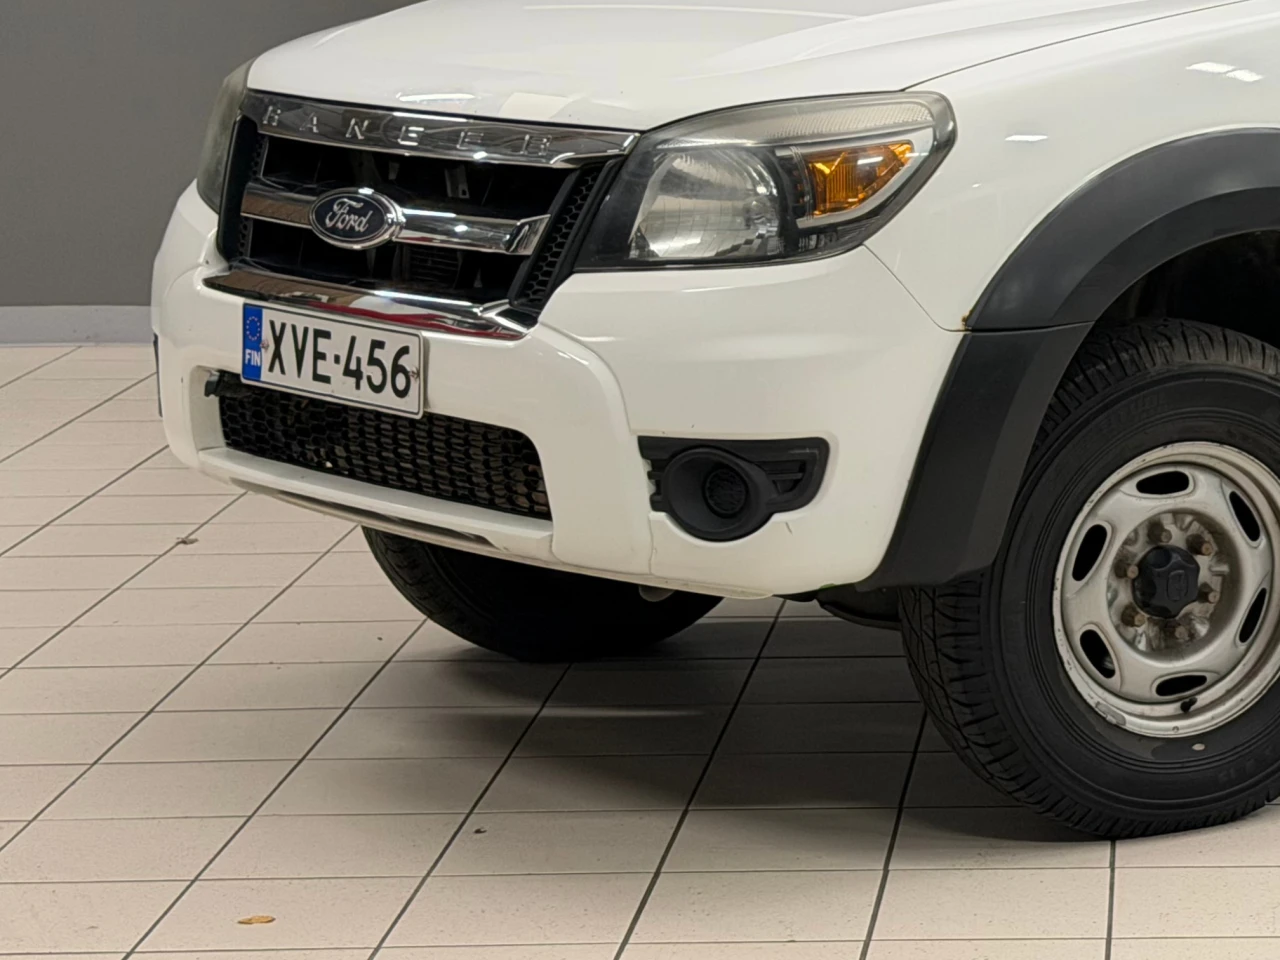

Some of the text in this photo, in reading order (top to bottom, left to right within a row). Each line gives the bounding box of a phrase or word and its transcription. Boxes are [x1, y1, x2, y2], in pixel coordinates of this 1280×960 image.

[325, 198, 373, 232] Ford
[245, 348, 261, 367] FIN
[268, 319, 411, 398] XVE-456
